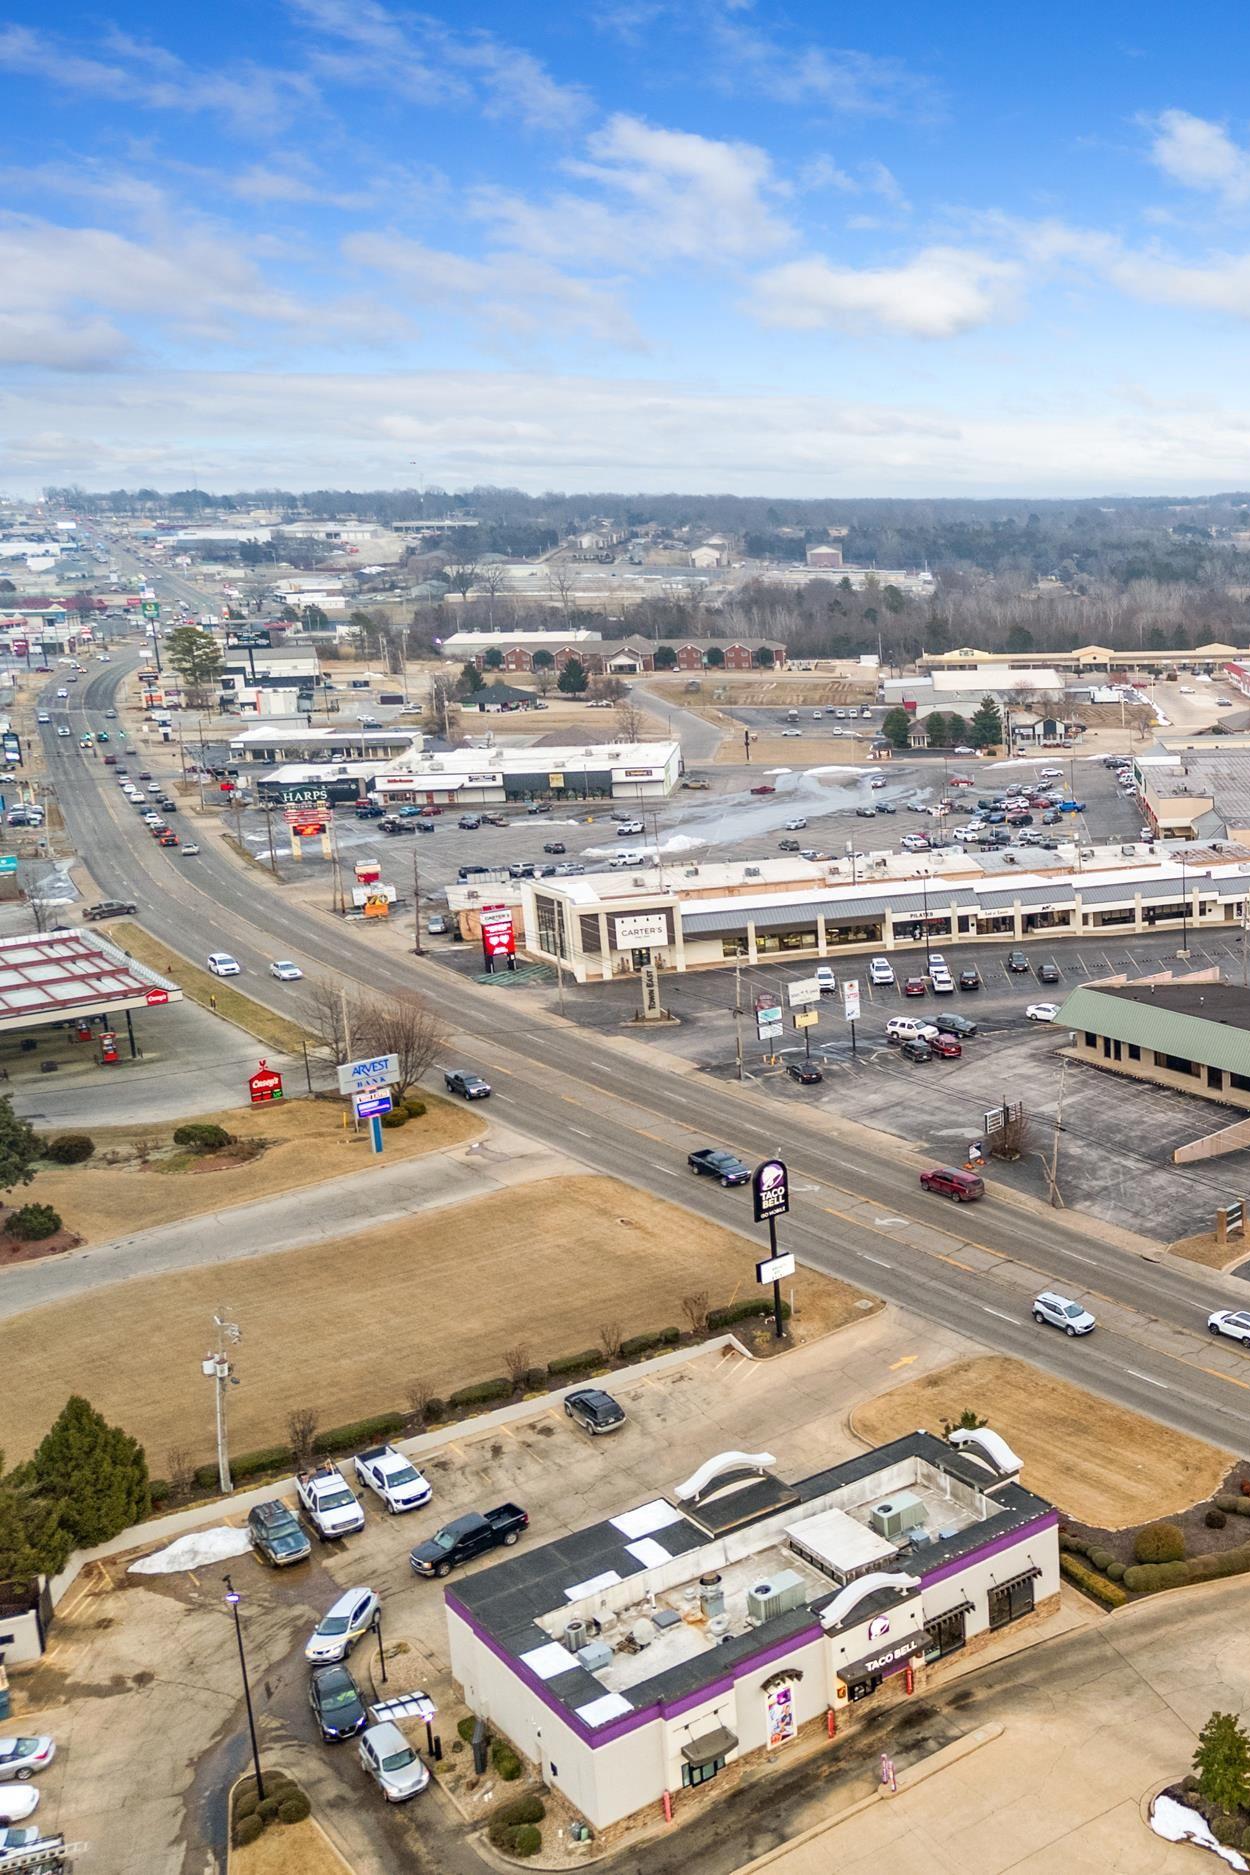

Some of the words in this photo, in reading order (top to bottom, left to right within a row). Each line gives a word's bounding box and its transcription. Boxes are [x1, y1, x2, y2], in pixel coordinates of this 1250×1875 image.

[283, 790, 328, 802] HARPS
[621, 926, 663, 937] CARTER'S
[646, 970, 654, 988] EAST
[648, 989, 656, 1011] TOWN
[352, 1059, 389, 1077] ARVEST
[357, 1076, 386, 1088] BANK
[759, 1186, 785, 1202] TACO
[762, 1196, 785, 1209] BELL
[865, 1653, 893, 1671] TACO
[894, 1641, 917, 1659] BELL
